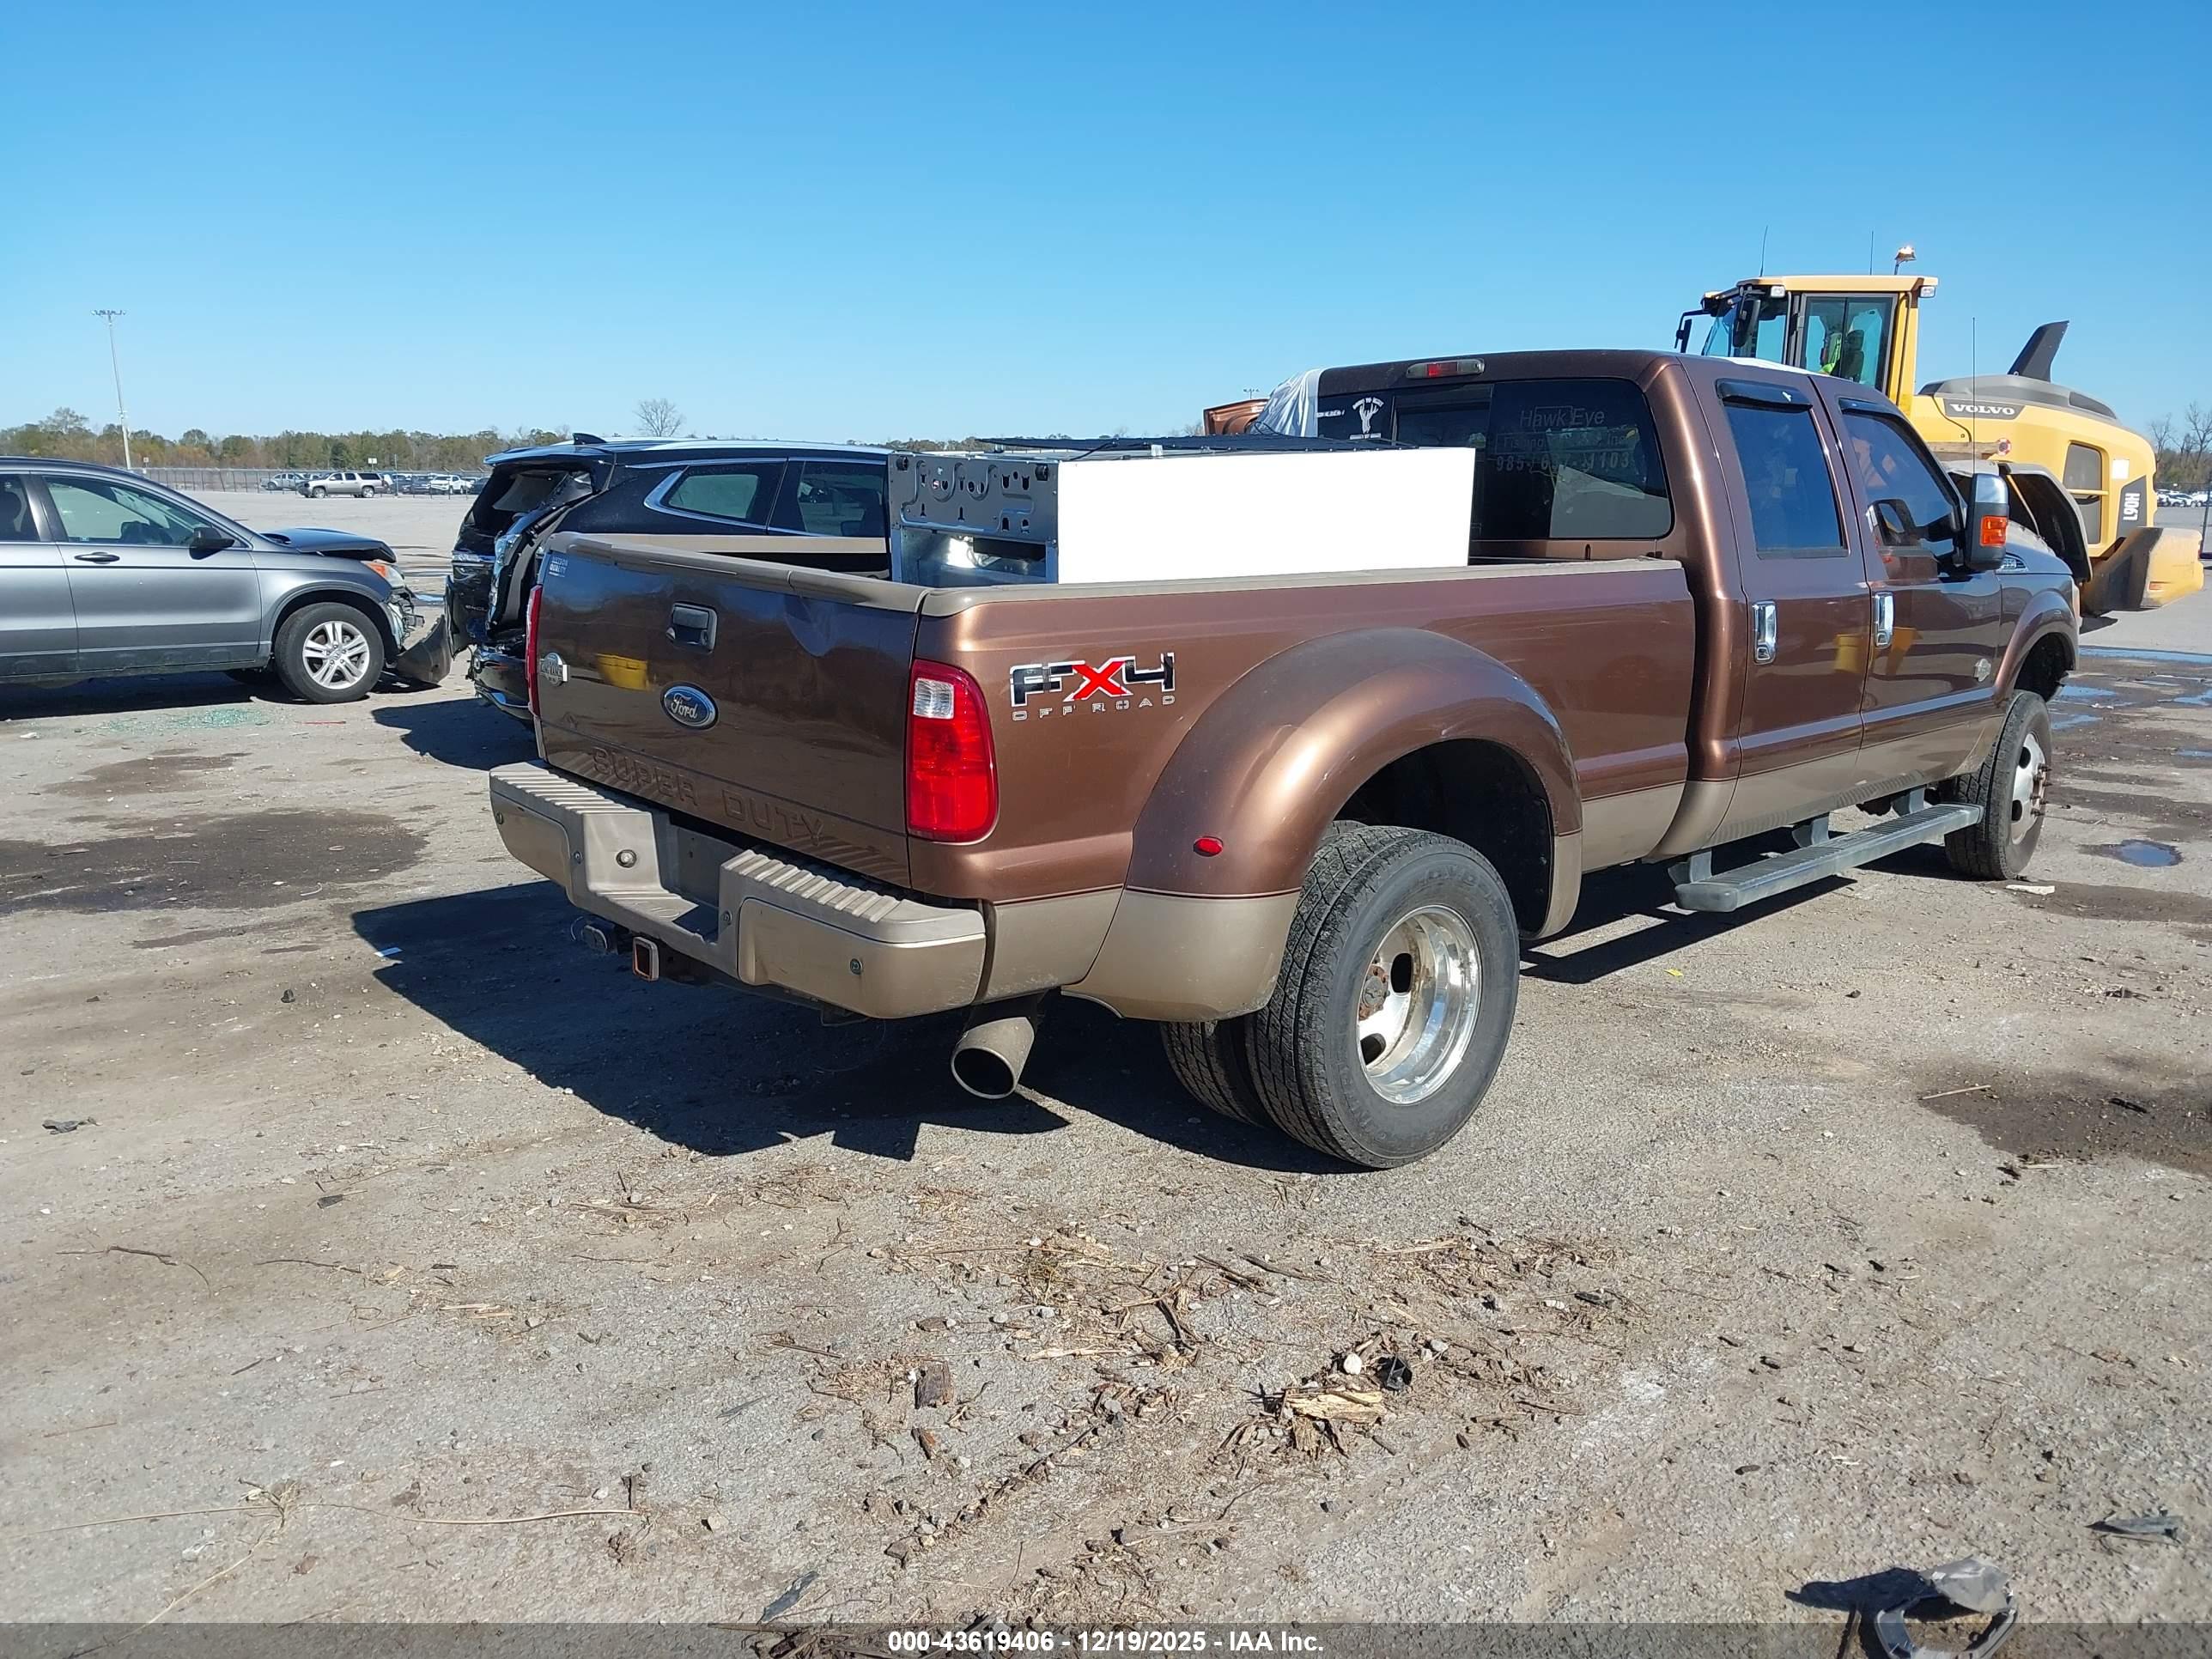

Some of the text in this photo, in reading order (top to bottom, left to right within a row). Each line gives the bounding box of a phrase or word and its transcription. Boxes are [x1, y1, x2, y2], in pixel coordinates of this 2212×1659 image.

[1520, 408, 1605, 428] Hawk Eye
[1950, 404, 2015, 415] VOLVO
[2123, 493, 2141, 520] L90H
[1010, 653, 1175, 707] FX4
[671, 693, 698, 719] Ford
[1012, 695, 1176, 721] OFF ROAD
[592, 746, 825, 842] SUPER DUTY
